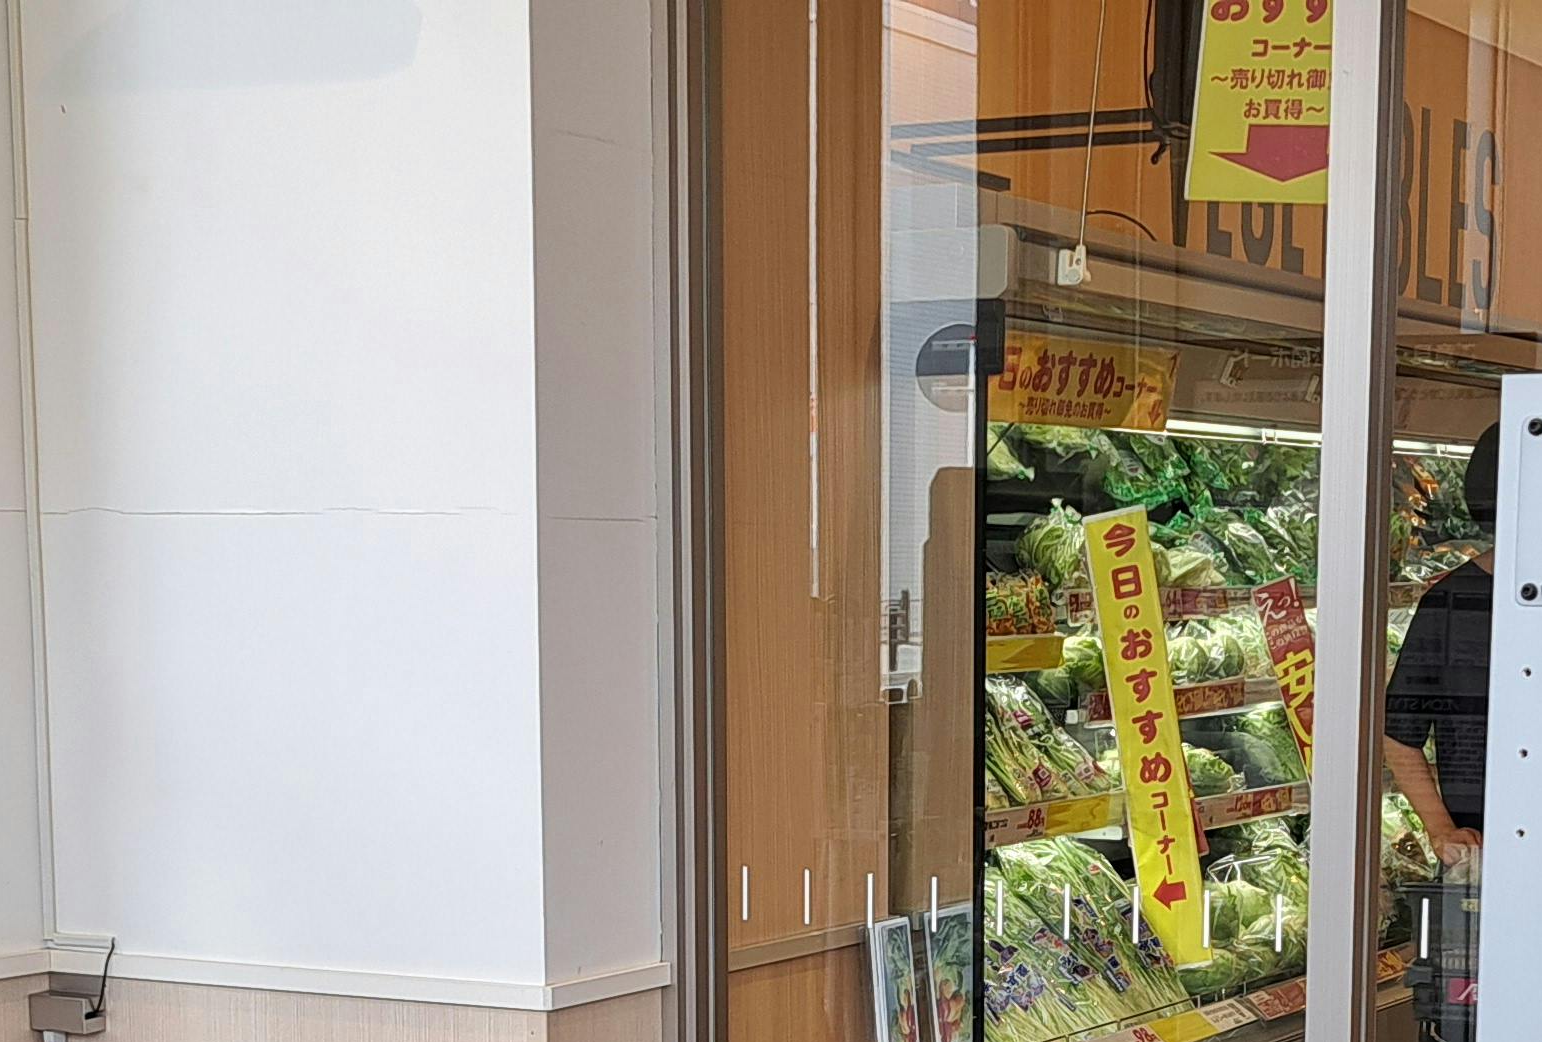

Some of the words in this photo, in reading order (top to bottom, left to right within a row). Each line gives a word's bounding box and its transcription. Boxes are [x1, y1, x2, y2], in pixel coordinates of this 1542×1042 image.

[1209, 67, 1332, 89] 〜売り切れ御
